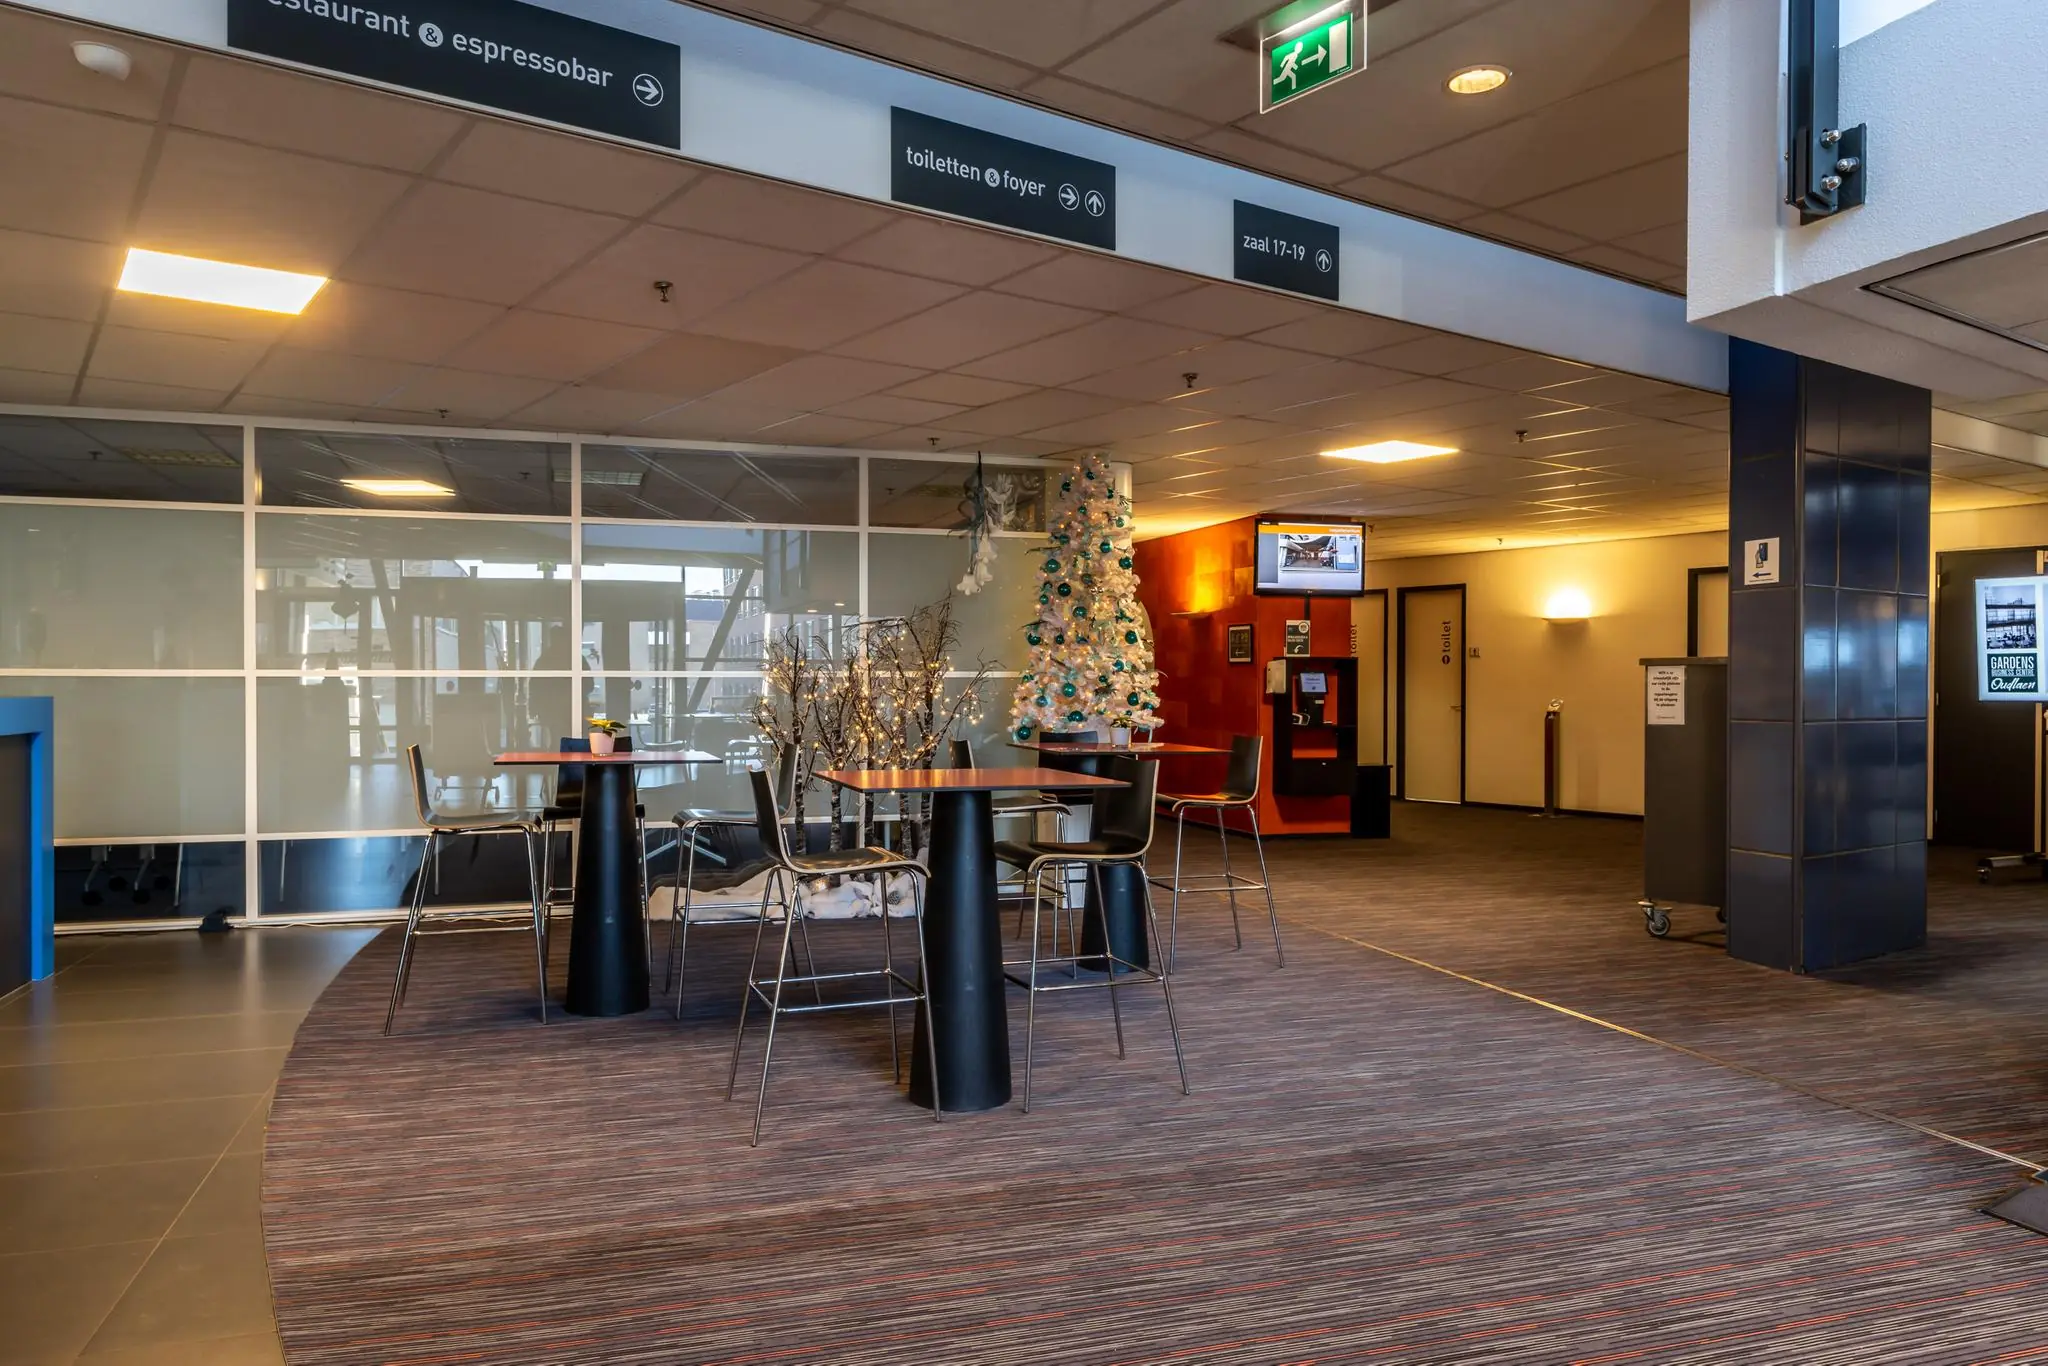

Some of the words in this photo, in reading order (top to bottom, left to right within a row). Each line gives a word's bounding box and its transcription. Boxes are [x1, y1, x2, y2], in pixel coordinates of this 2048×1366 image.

[452, 33, 613, 87] espressobar
[906, 146, 981, 182] toiletten
[1003, 170, 1046, 197] foyer
[1243, 235, 1270, 253] zaal
[1273, 239, 1306, 261] 17-19
[1441, 620, 1452, 653] toilet
[1990, 656, 2035, 669] GARDENS
[2015, 668, 2035, 677] CENTRE
